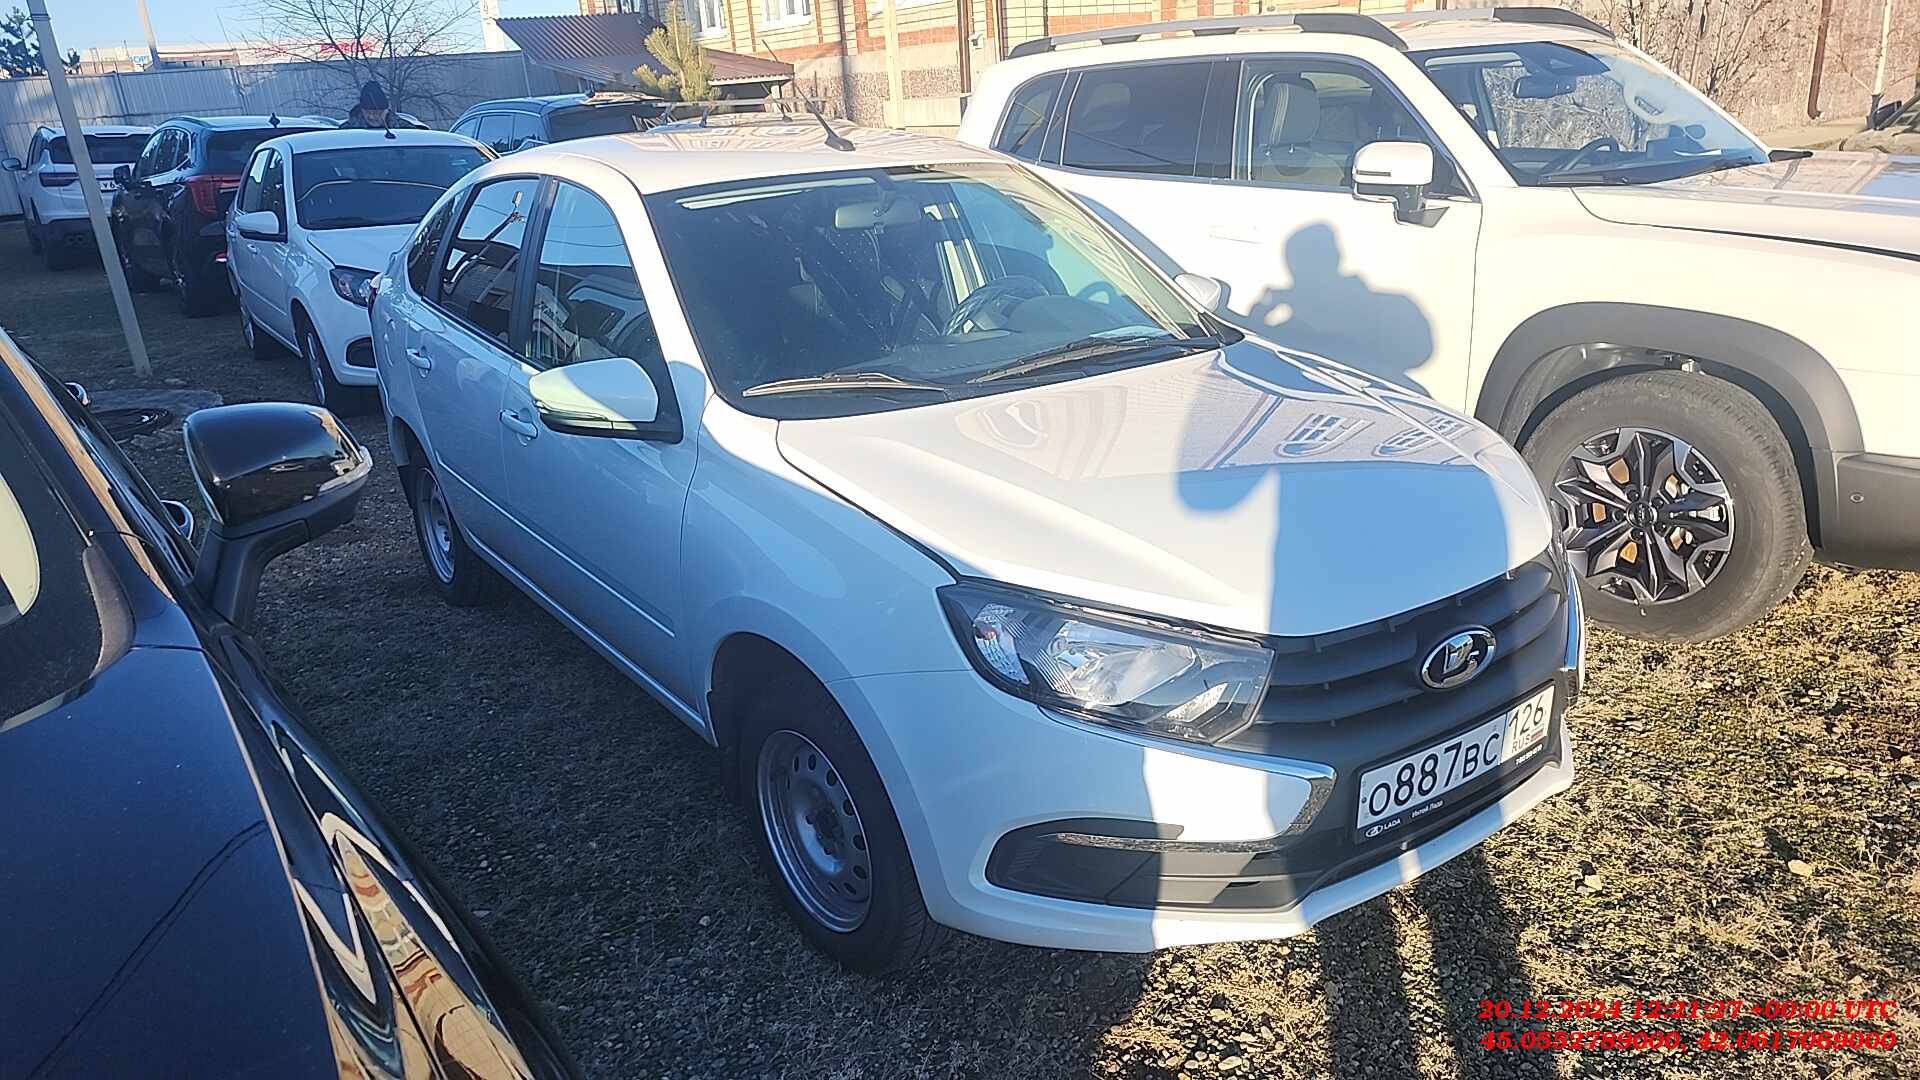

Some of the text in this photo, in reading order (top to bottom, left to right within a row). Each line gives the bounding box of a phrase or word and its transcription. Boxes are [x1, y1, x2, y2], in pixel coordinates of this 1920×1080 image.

[1508, 695, 1544, 740] 126
[1512, 734, 1531, 753] RUS
[1384, 818, 1401, 830] LADA
